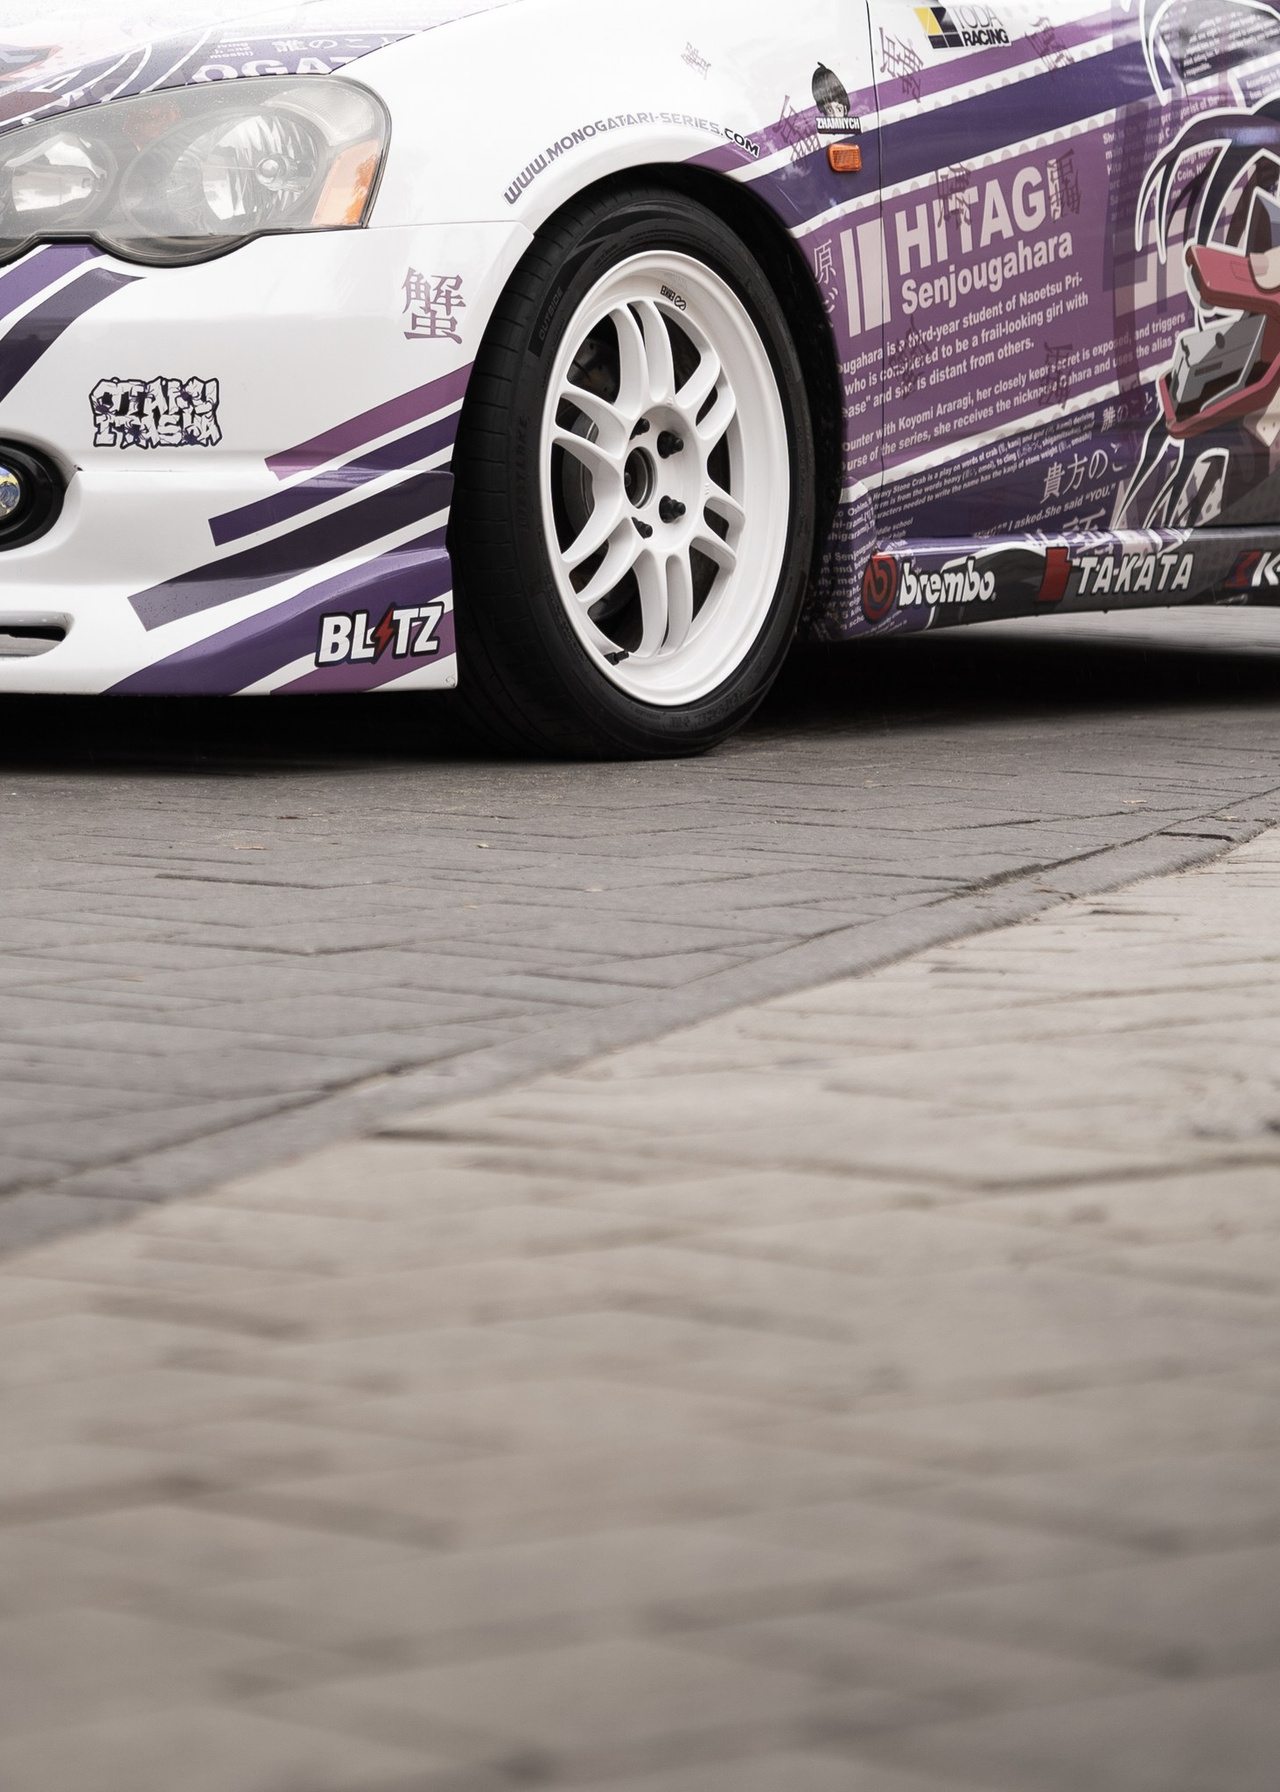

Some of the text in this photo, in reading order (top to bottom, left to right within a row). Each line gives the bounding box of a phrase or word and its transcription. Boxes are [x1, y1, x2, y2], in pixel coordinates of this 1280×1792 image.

[952, 5, 1005, 28] TODA
[962, 29, 1009, 46] RACING
[503, 112, 760, 206] WWW.MONOGATARI-SERIES.COM
[895, 158, 1063, 276] HITAGI
[401, 266, 467, 345] 蟹
[901, 231, 1074, 315] Senjougahara
[539, 287, 564, 341] OUTSIDE
[844, 291, 1089, 396] who is considered to be a frail-looking girl with
[909, 319, 961, 348] third-year
[962, 300, 1004, 330] student
[1005, 294, 1017, 312] of
[1019, 281, 1063, 308] Naoetsu
[1065, 272, 1083, 290] Pri-
[869, 446, 880, 461] of
[881, 442, 897, 457] the
[899, 430, 931, 450] series,
[933, 422, 951, 438] she
[953, 405, 995, 430] receives
[995, 399, 1012, 414] the
[1013, 380, 1058, 408] nickname
[1094, 357, 1114, 374] and
[1135, 344, 1151, 360] the
[1151, 335, 1173, 353] alias
[873, 386, 893, 408] and
[916, 376, 927, 391] is
[928, 359, 968, 386] distant
[969, 351, 995, 371] from
[997, 337, 1035, 361] others.
[876, 421, 897, 441] with
[898, 406, 934, 432] Koyomi
[935, 391, 975, 418] Araragi,
[976, 387, 993, 402] her
[994, 372, 1027, 395] closely
[1029, 364, 1050, 382] kept
[1051, 351, 1081, 374] secret
[1082, 348, 1091, 362] is
[1092, 331, 1133, 358] exposed,
[1134, 323, 1151, 341] and
[1151, 312, 1187, 334] triggers
[893, 481, 911, 494] Stone
[911, 476, 927, 487] Crab
[939, 466, 953, 479] play
[935, 487, 951, 500] write
[1063, 495, 1084, 512] said
[898, 557, 995, 606] brembo
[1077, 553, 1195, 595] TAKATA
